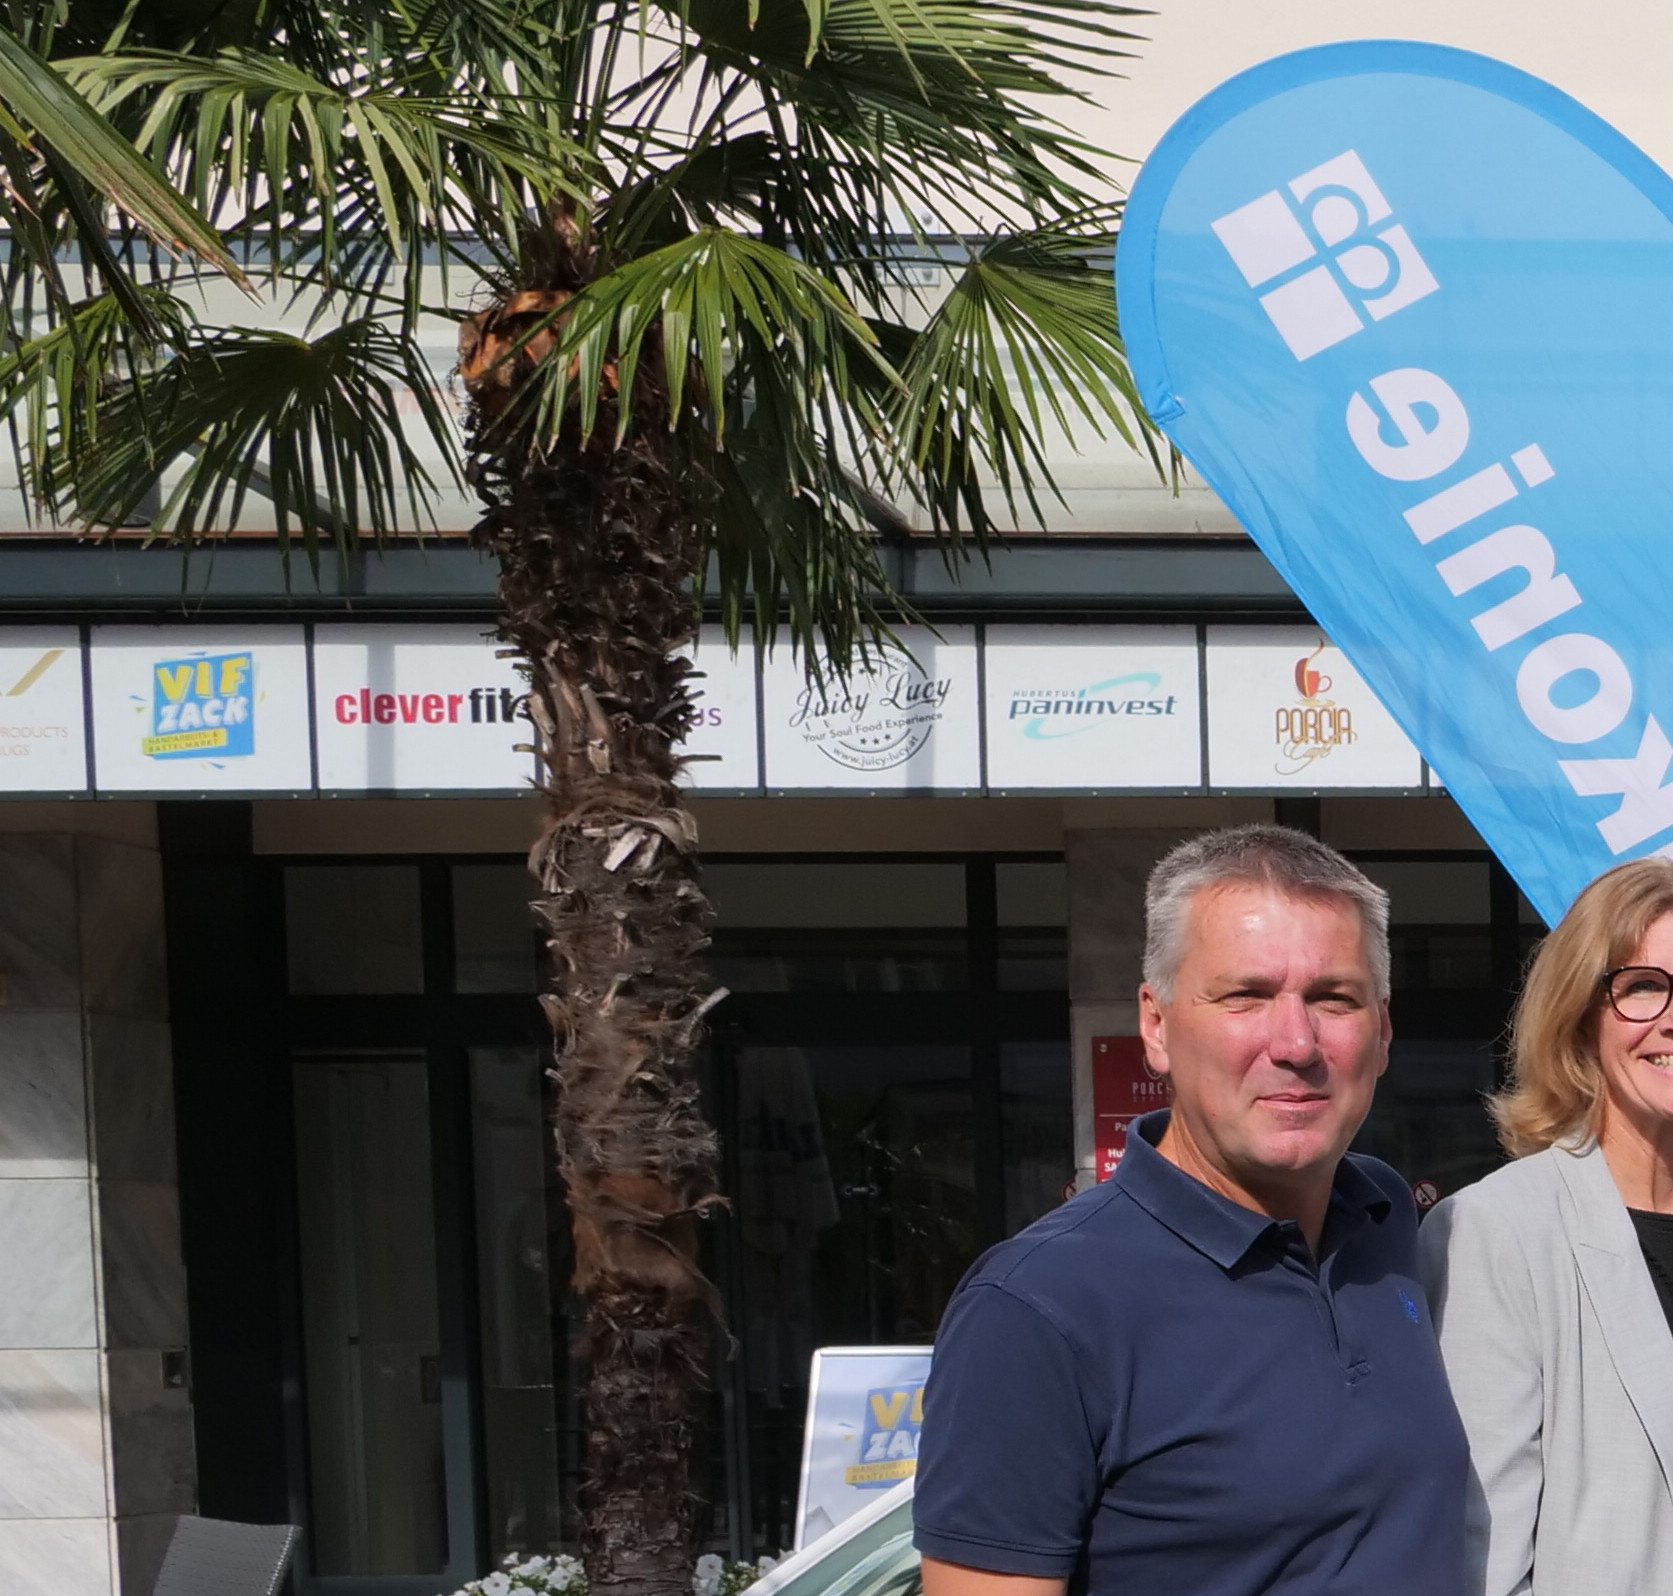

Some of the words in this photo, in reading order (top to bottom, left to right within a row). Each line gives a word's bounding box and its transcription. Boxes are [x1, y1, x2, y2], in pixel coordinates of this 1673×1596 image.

[156, 656, 249, 702] VIF
[1013, 690, 1077, 698] HUBERTUS
[157, 696, 249, 733] ZACK
[789, 686, 869, 727] Juicy
[880, 672, 951, 710] Lucy
[1008, 690, 1177, 719] paninvest
[0, 727, 69, 738] RODUCTS
[802, 733, 826, 743] Your
[830, 726, 852, 739] Soul
[856, 721, 881, 734] Food
[885, 713, 943, 730] Experience
[1275, 707, 1352, 745] PORCIA
[833, 736, 919, 767] www.juicy-lucy.at
[870, 1387, 925, 1431] VI
